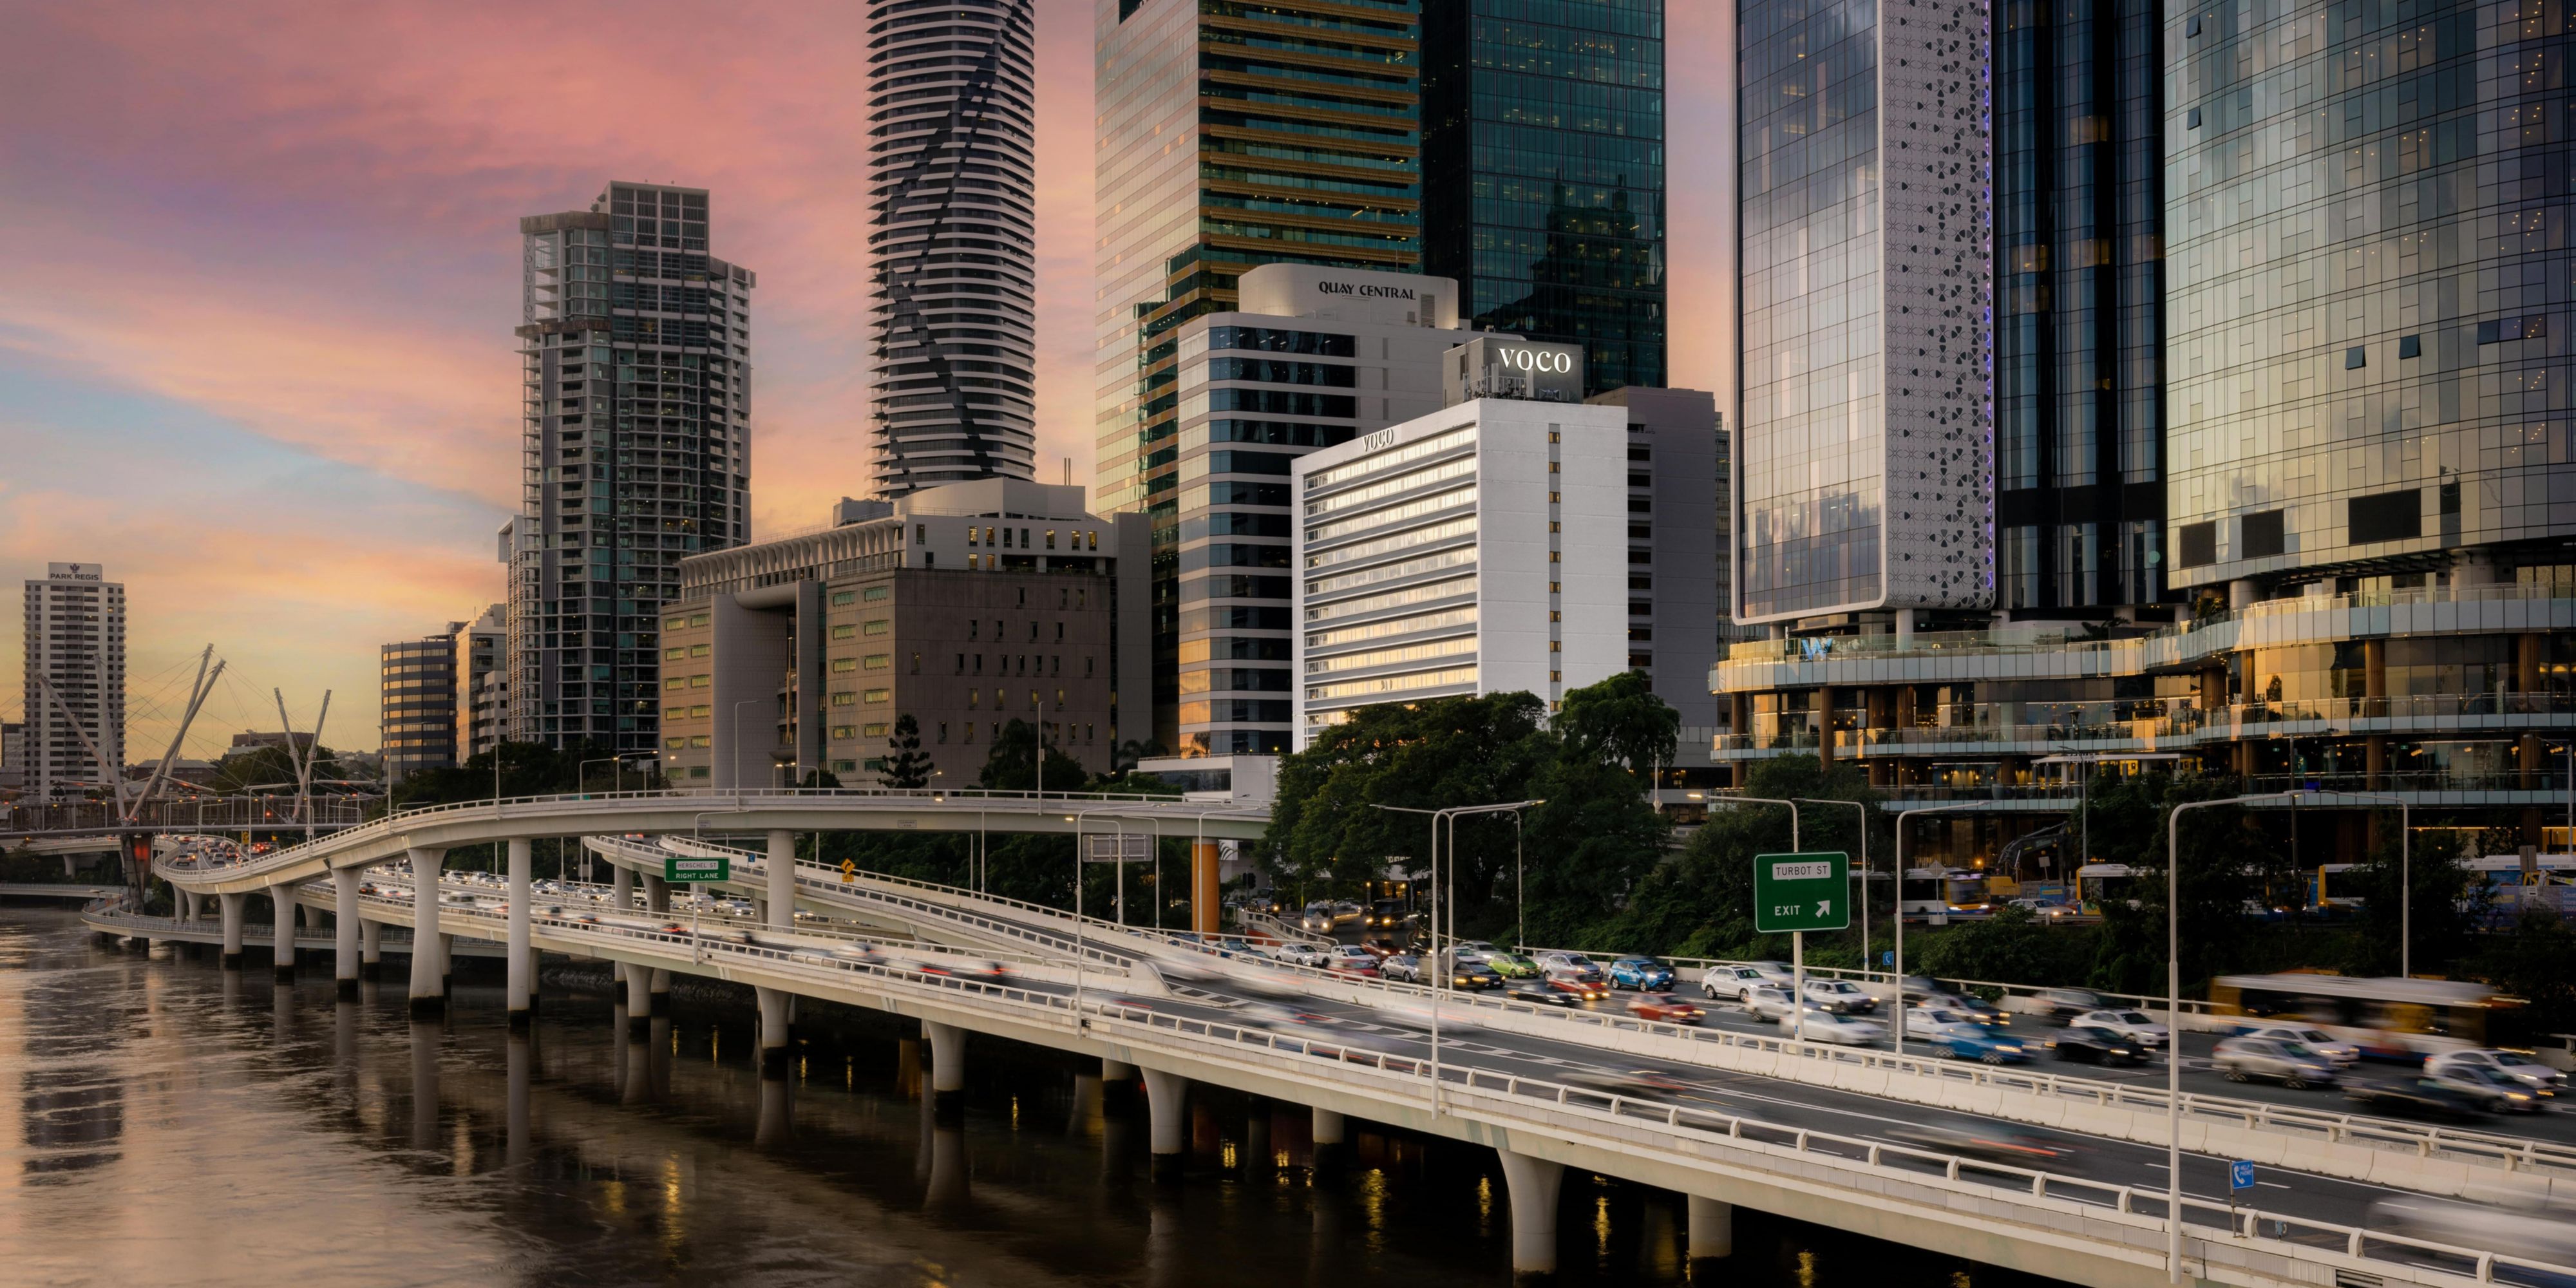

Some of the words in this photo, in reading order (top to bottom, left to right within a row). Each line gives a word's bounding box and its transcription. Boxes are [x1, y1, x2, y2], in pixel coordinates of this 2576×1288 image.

[524, 235, 533, 322] EVOLUTION
[1318, 281, 1354, 294] QUAY
[1359, 285, 1416, 300] CENTRAL
[1801, 638, 1833, 660] W
[1776, 866, 1812, 876] TURBOT
[1817, 866, 1828, 875] ST
[1774, 905, 1801, 916] EXIT
